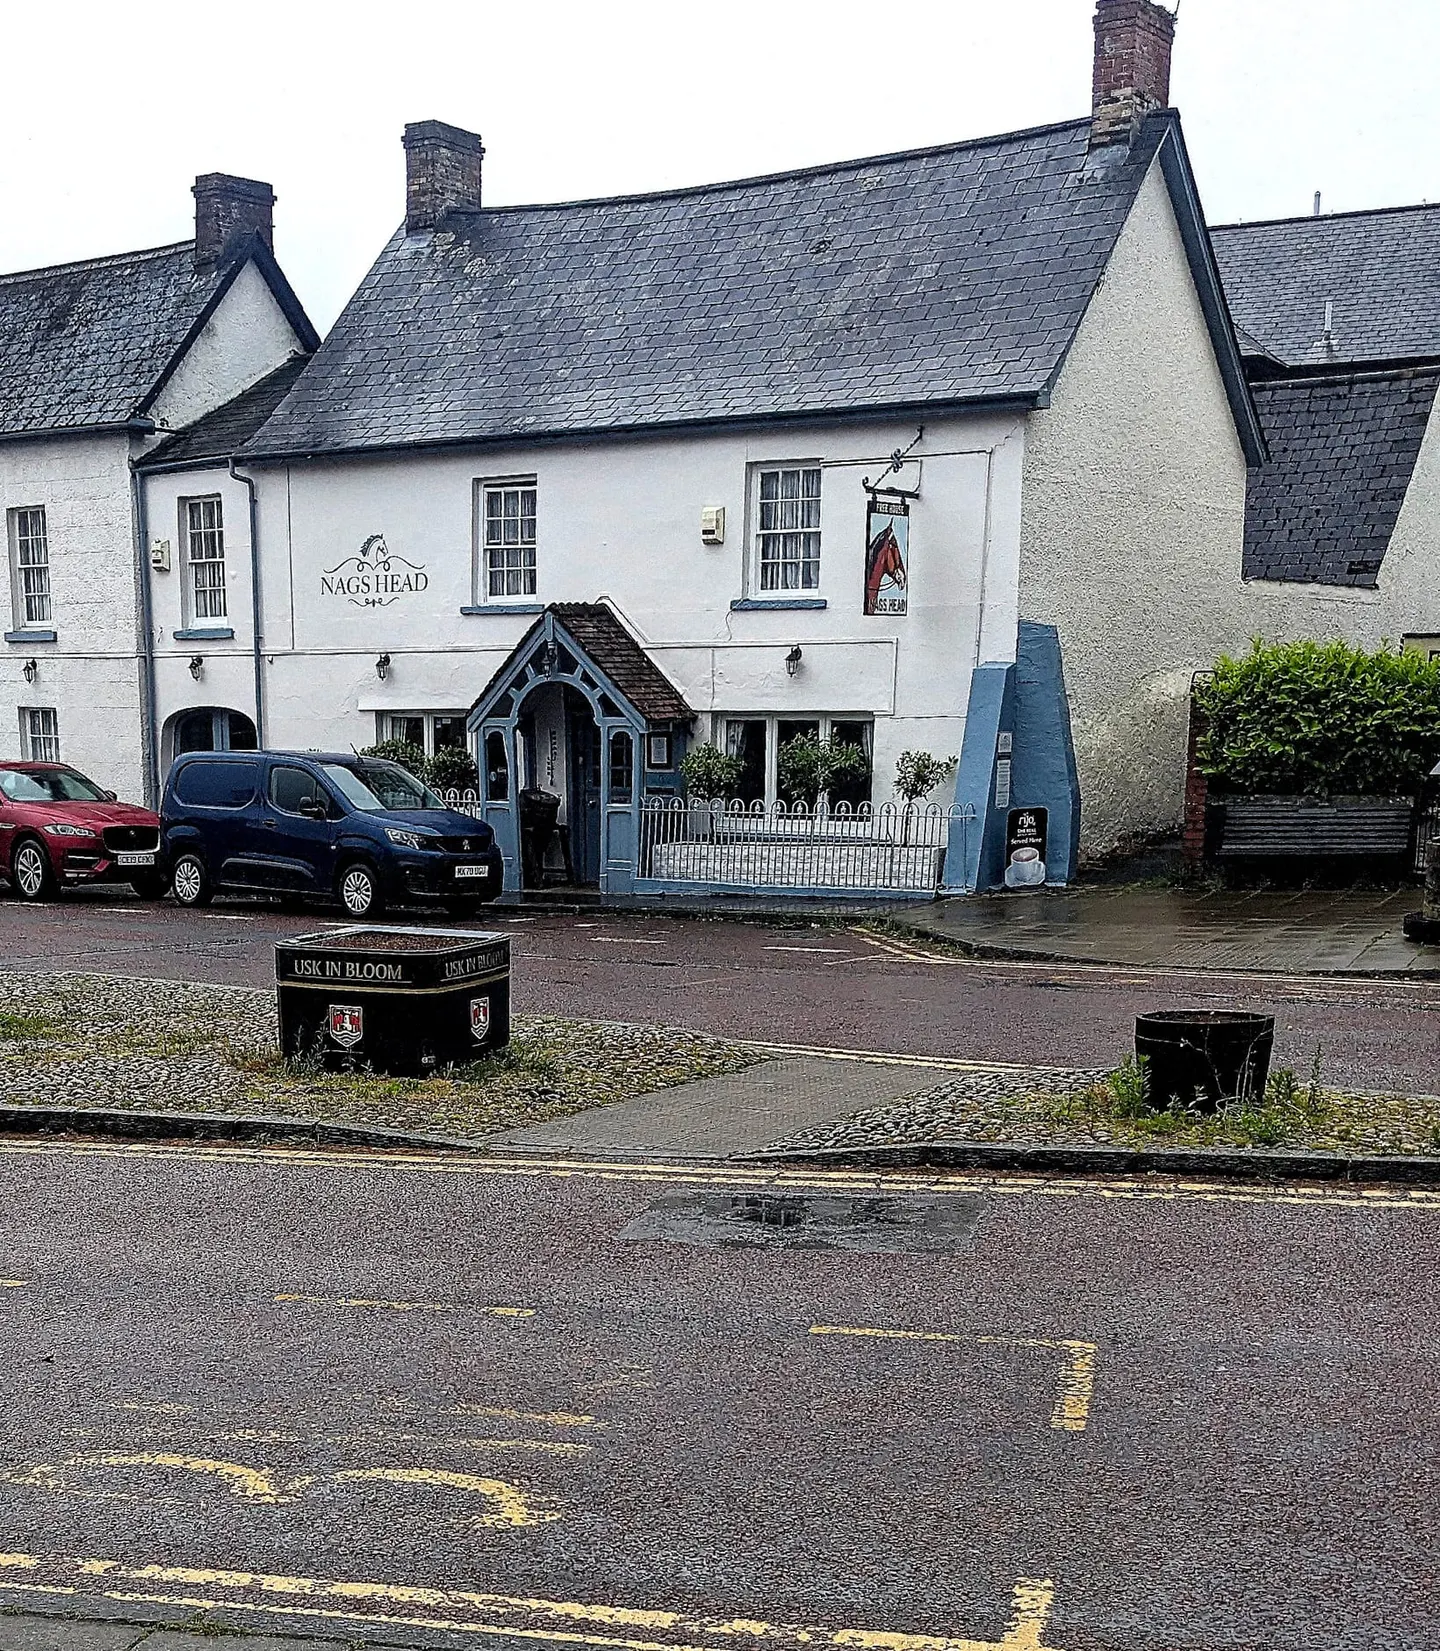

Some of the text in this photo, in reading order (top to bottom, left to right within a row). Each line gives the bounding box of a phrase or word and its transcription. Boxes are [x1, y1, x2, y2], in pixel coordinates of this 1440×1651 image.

[876, 503, 905, 515] FREE HOUSE
[321, 572, 428, 595] NAGS HEAD
[889, 598, 906, 612] HEAD
[294, 959, 402, 980] USK IN BLOOM
[445, 949, 504, 978] USK IN BLOOM
